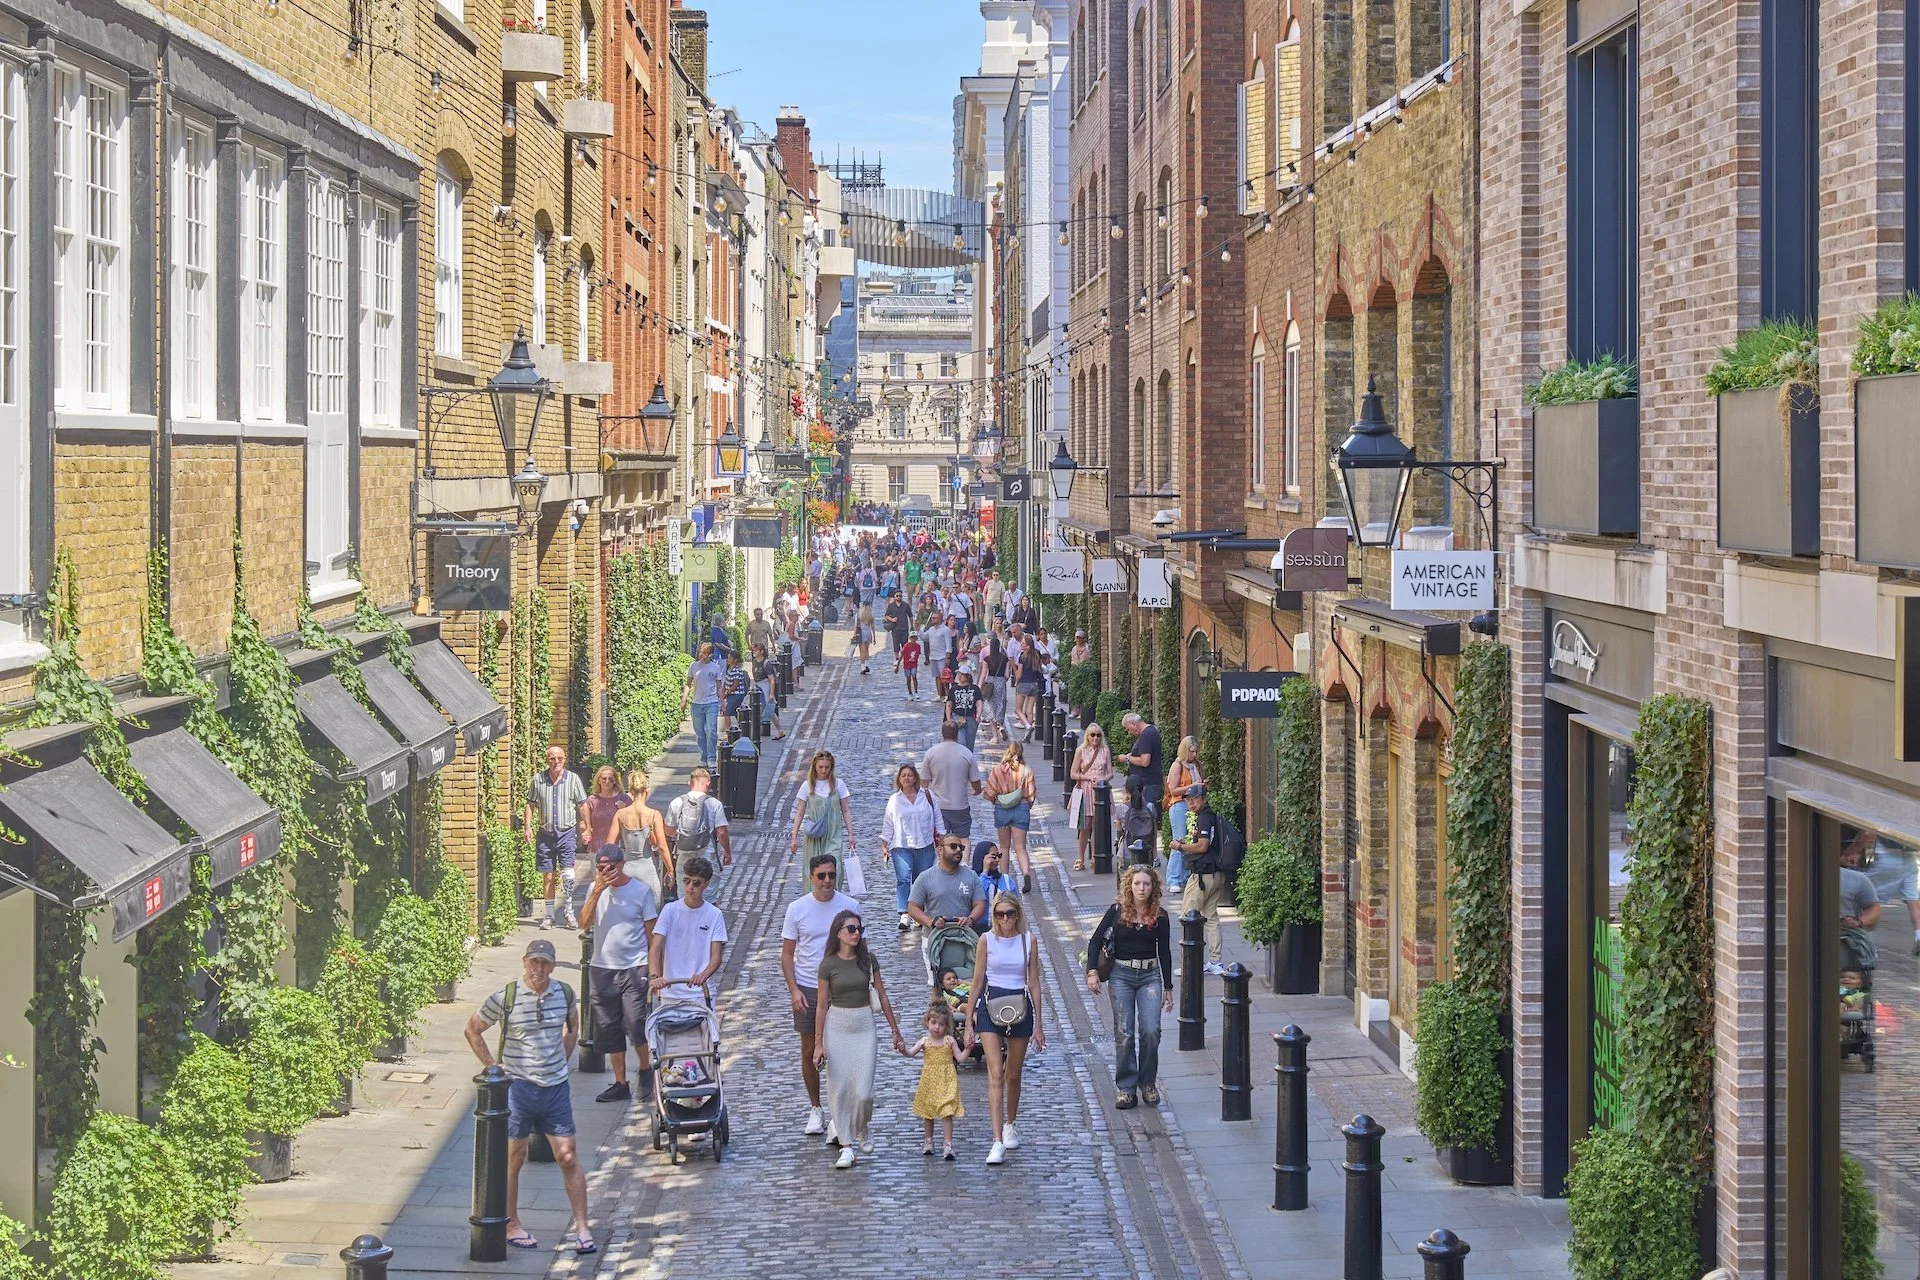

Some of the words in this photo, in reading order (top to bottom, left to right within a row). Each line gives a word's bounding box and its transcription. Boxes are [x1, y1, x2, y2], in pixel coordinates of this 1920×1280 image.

[671, 520, 679, 574] ARKET
[1286, 551, 1346, 567] sessùn
[445, 564, 500, 581] Theory
[1046, 566, 1080, 581] Rails
[1402, 564, 1486, 579] AMERICAN
[1095, 583, 1126, 592] GANNI
[1411, 582, 1478, 597] VINTAGE
[1141, 598, 1169, 606] A.P.C.
